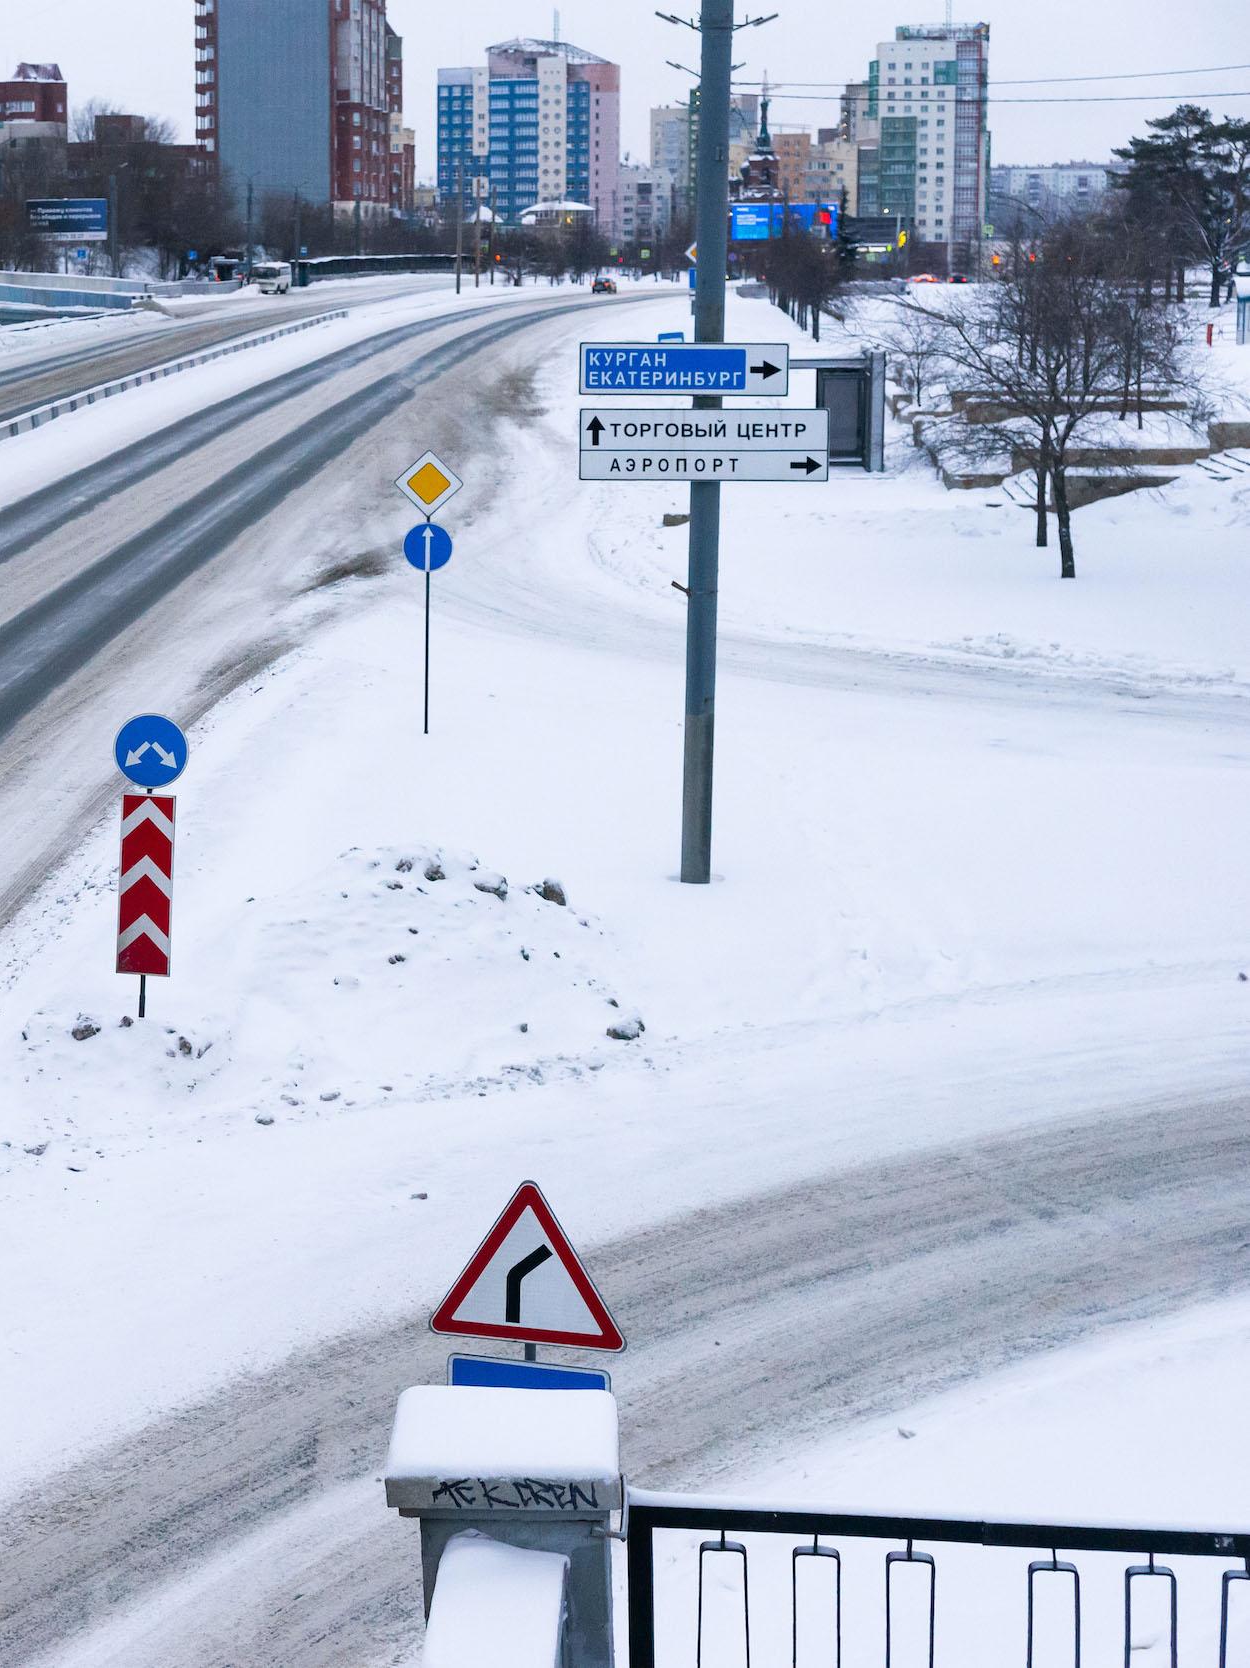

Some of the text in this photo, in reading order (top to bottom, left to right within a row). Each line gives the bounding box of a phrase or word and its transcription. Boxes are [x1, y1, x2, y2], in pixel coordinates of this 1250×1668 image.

[589, 352, 667, 367] КУРГАН
[589, 371, 742, 386] ЕКАТЕРИНБУРГ
[610, 420, 807, 440] ТОРГОВЫЙ ЦЕНТР
[610, 458, 739, 472] АЭРОПОРТ
